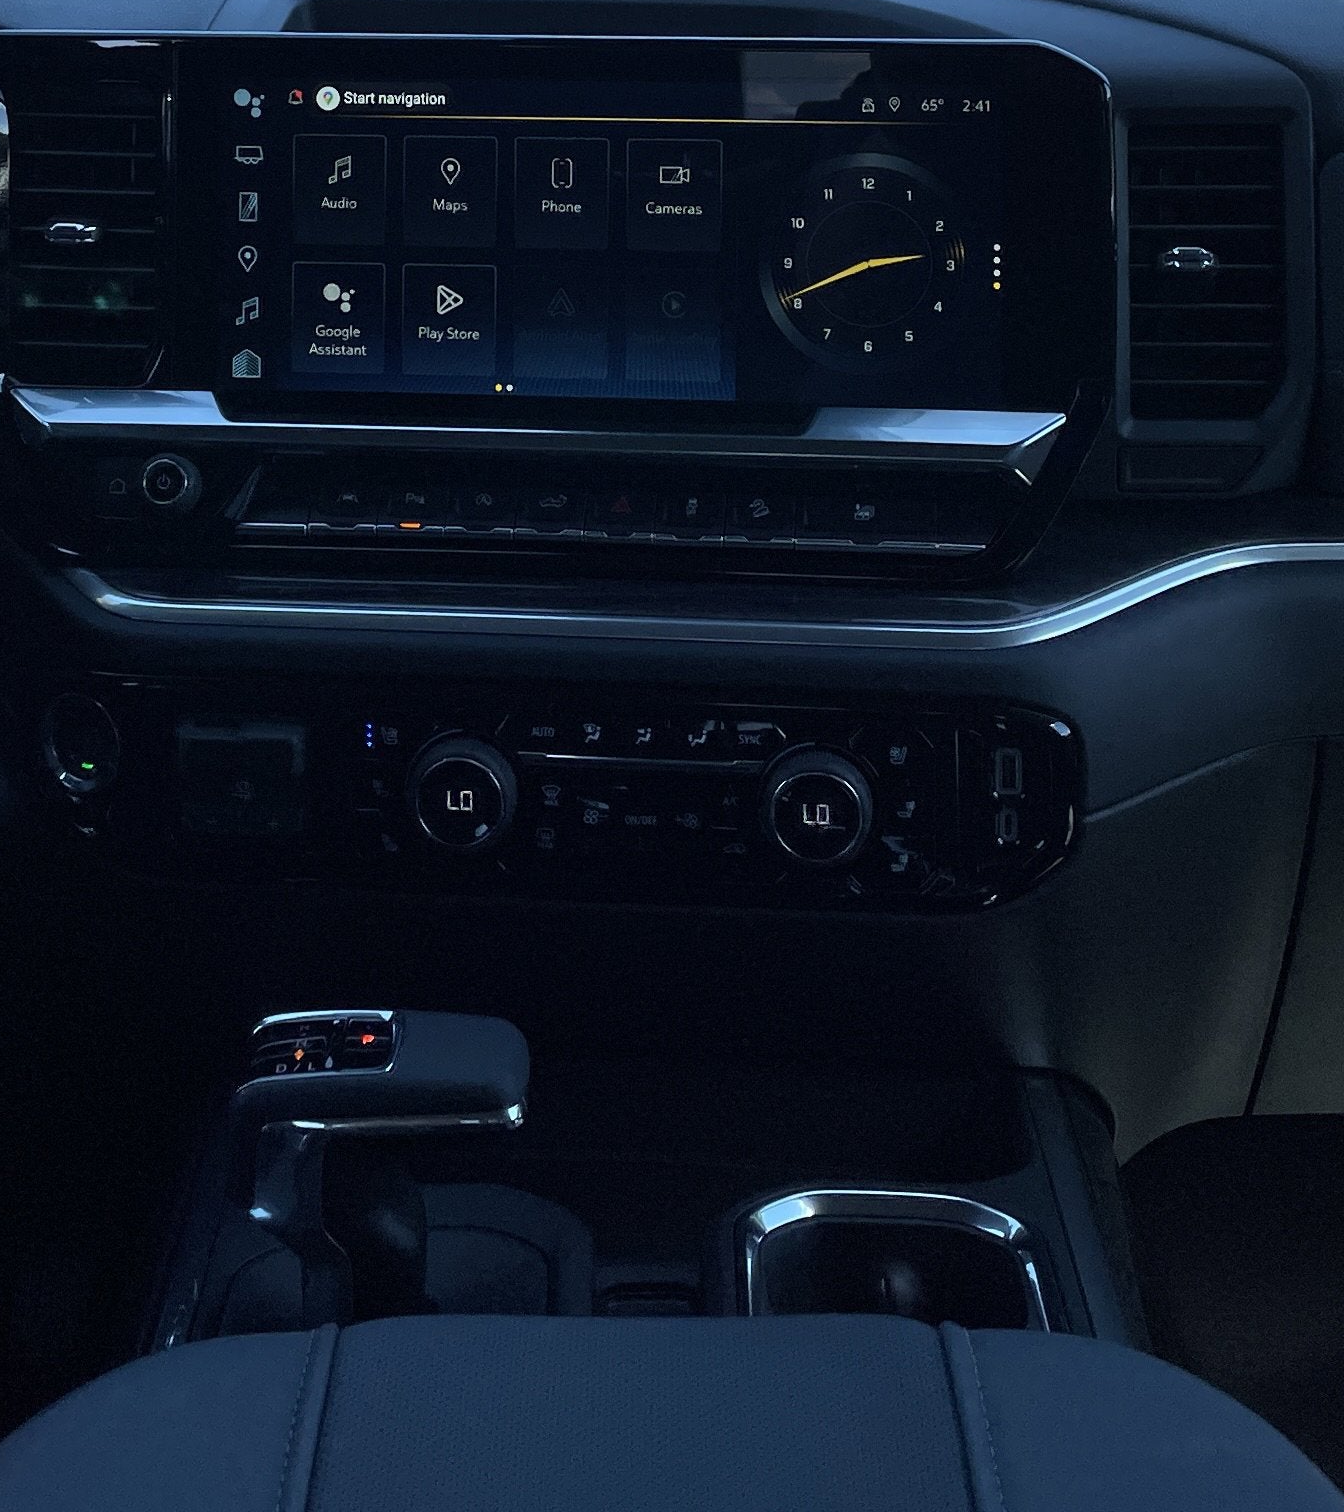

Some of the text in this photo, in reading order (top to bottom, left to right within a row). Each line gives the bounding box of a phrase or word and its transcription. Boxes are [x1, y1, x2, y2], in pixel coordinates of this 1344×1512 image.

[343, 90, 446, 108] Start navigation
[921, 98, 990, 113] 65° 2:41
[861, 177, 875, 190] 12
[823, 188, 833, 200] 11
[906, 190, 912, 202] 1
[321, 196, 358, 209] Audio
[432, 198, 468, 214] Maps
[541, 199, 582, 213] Phone
[645, 201, 703, 215] Cameras
[790, 217, 805, 229] 10
[935, 220, 944, 232] 2
[783, 257, 793, 269] 9
[946, 259, 955, 272] 3
[793, 297, 803, 310] 8
[933, 301, 943, 313] 4
[315, 324, 361, 341] Google
[418, 326, 480, 343] Play Store
[823, 328, 832, 340] 7
[904, 330, 914, 342] 5
[308, 342, 367, 356] Assistant
[863, 340, 873, 353] 6
[531, 726, 555, 738] AUTO
[737, 733, 762, 745] SYNC
[446, 790, 473, 811] LO
[624, 814, 658, 827] ON/OFF
[802, 803, 830, 826] LO
